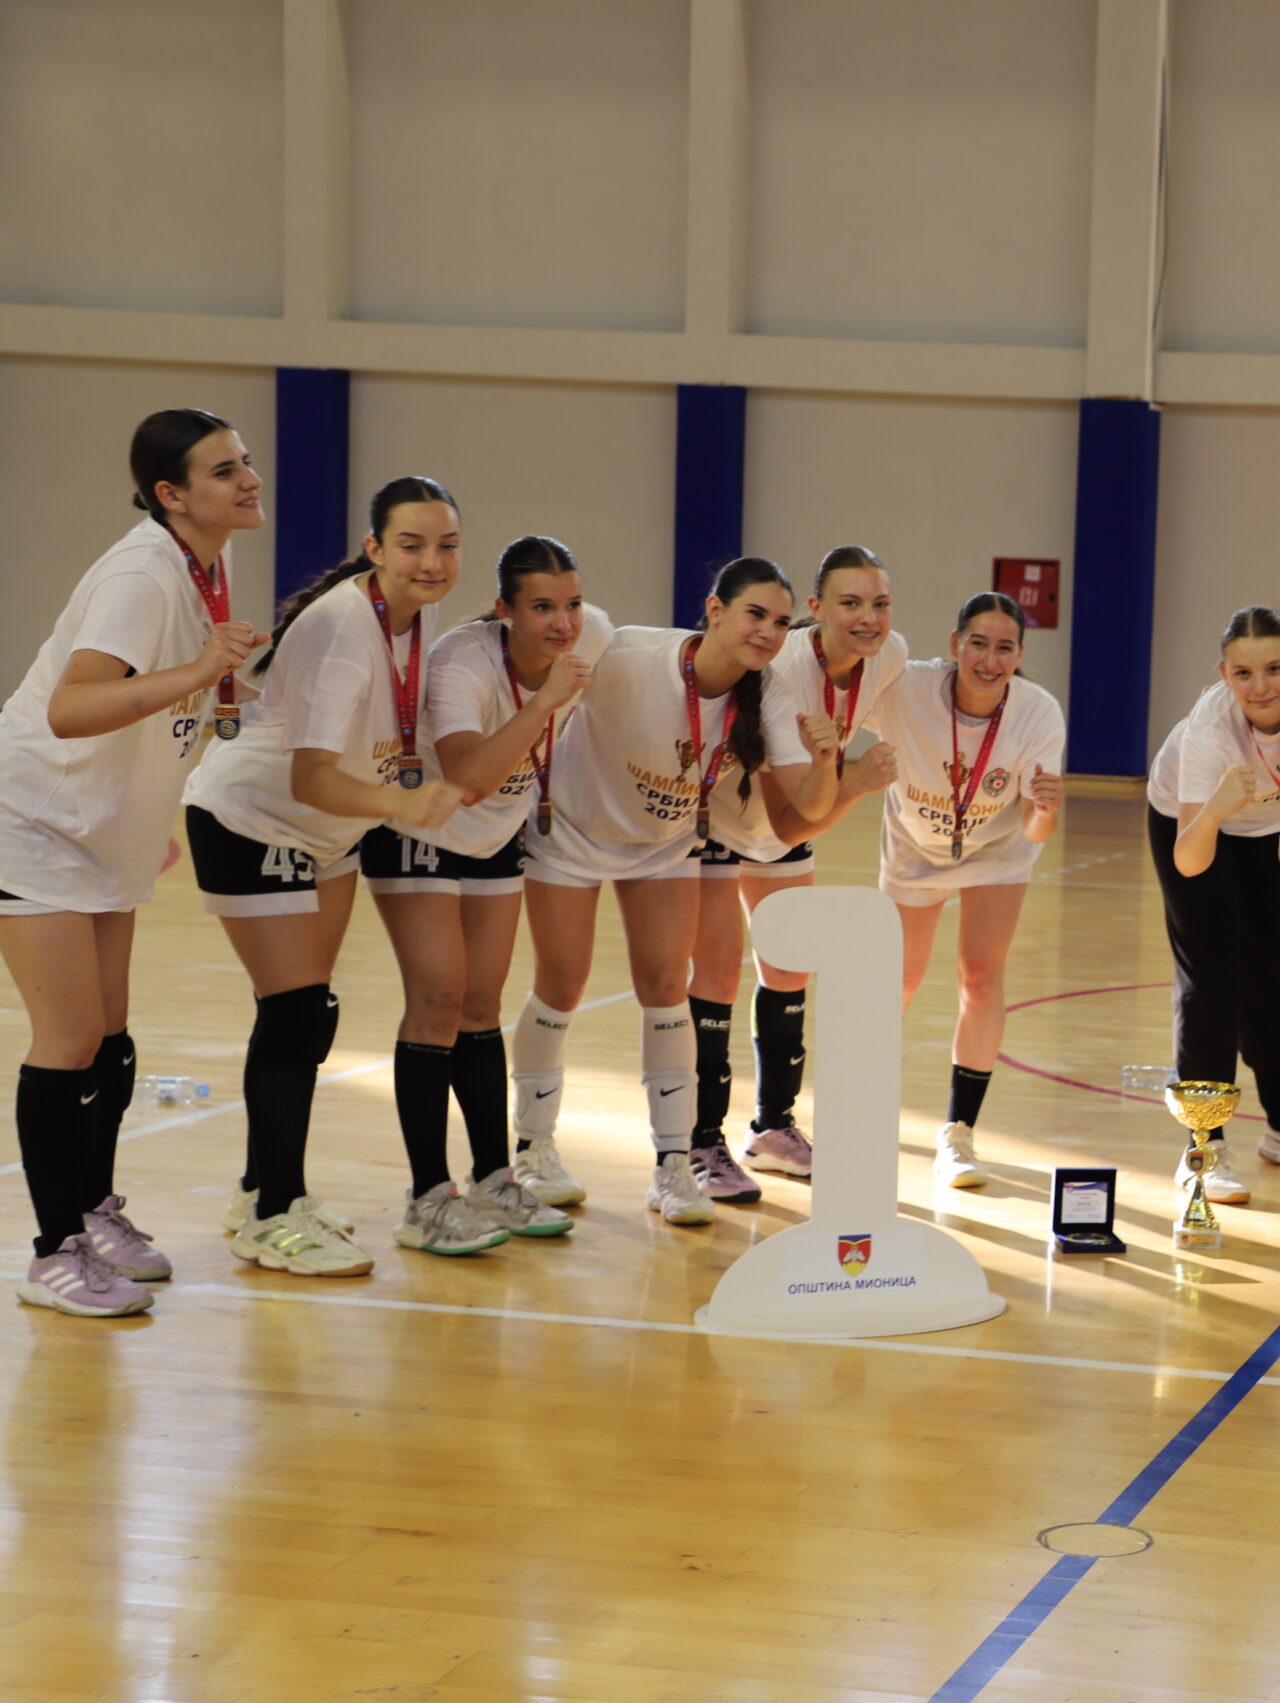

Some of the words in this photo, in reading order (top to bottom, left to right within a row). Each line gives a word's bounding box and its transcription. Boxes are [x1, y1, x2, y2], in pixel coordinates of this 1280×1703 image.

[636, 782, 701, 808] СРБИЈ
[906, 783, 1006, 816] ШАМПОНИ
[397, 835, 440, 873] 14
[788, 1280, 852, 1295] ОПШТИНА
[855, 1275, 917, 1290] МИОНИЦА
